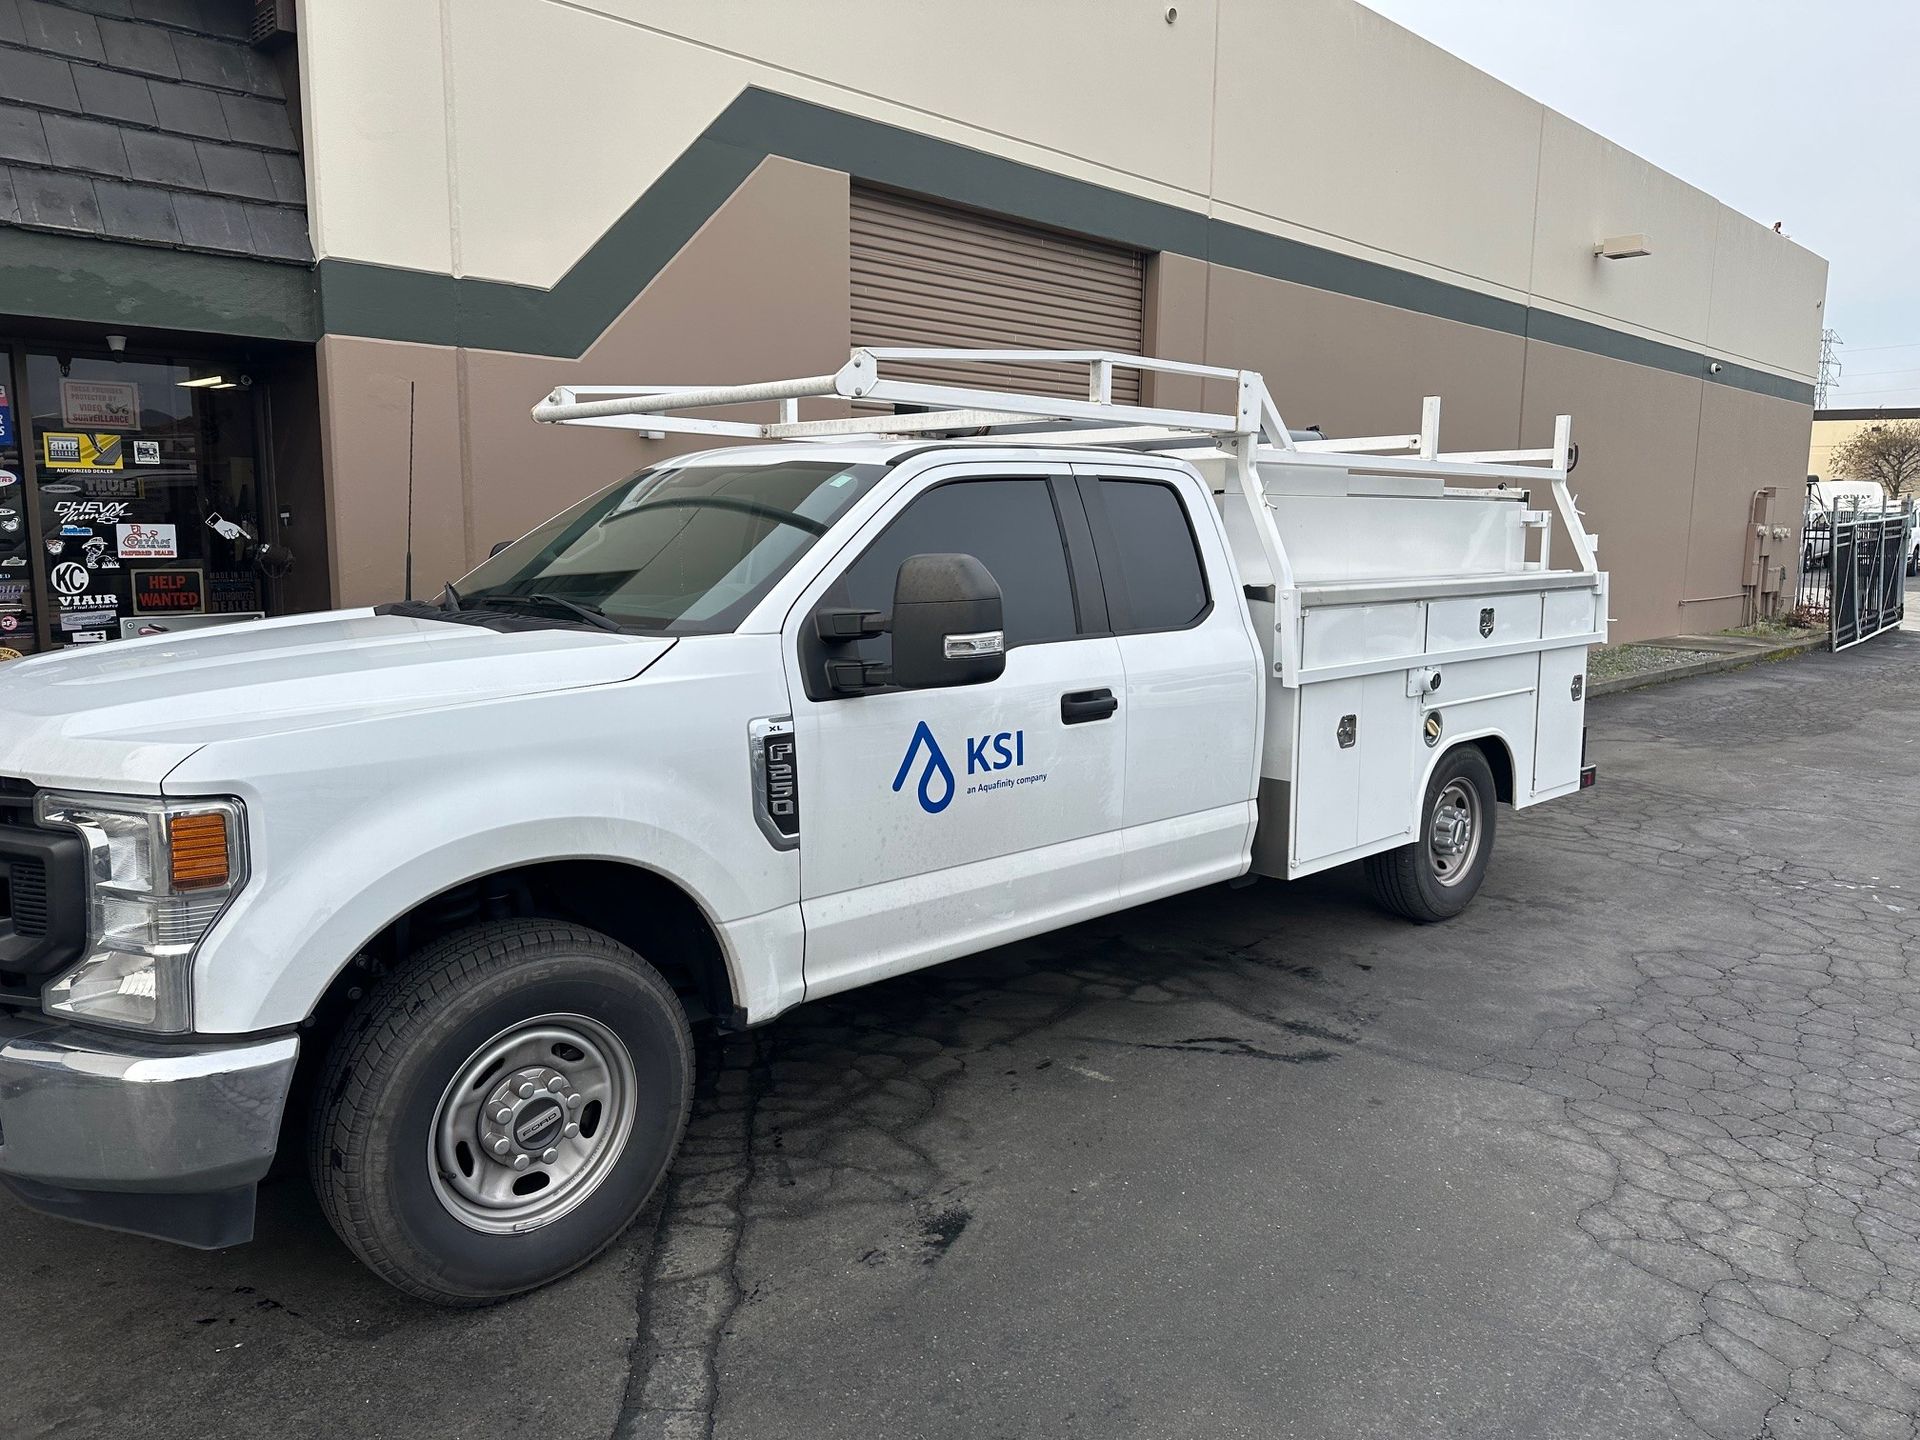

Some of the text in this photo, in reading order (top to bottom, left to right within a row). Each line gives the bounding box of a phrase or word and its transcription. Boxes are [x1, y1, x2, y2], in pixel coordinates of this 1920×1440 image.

[79, 403, 103, 412] VIDEO
[73, 413, 129, 424] SURVEILLANCE
[50, 442, 78, 450] AMP
[84, 479, 136, 491] THULE
[54, 501, 129, 513] CHEVY
[59, 506, 133, 524] Thunder
[55, 563, 86, 593] KC
[149, 575, 186, 590] HELP
[58, 594, 119, 606] VIAIR
[139, 592, 199, 606] WANTED
[212, 591, 255, 601] AUTHORIZED
[212, 601, 255, 611] DEALER
[967, 730, 1024, 775] KSI
[769, 742, 794, 816] F250
[966, 773, 1048, 795] an Aquafinity company
[522, 1112, 558, 1137] FORD
